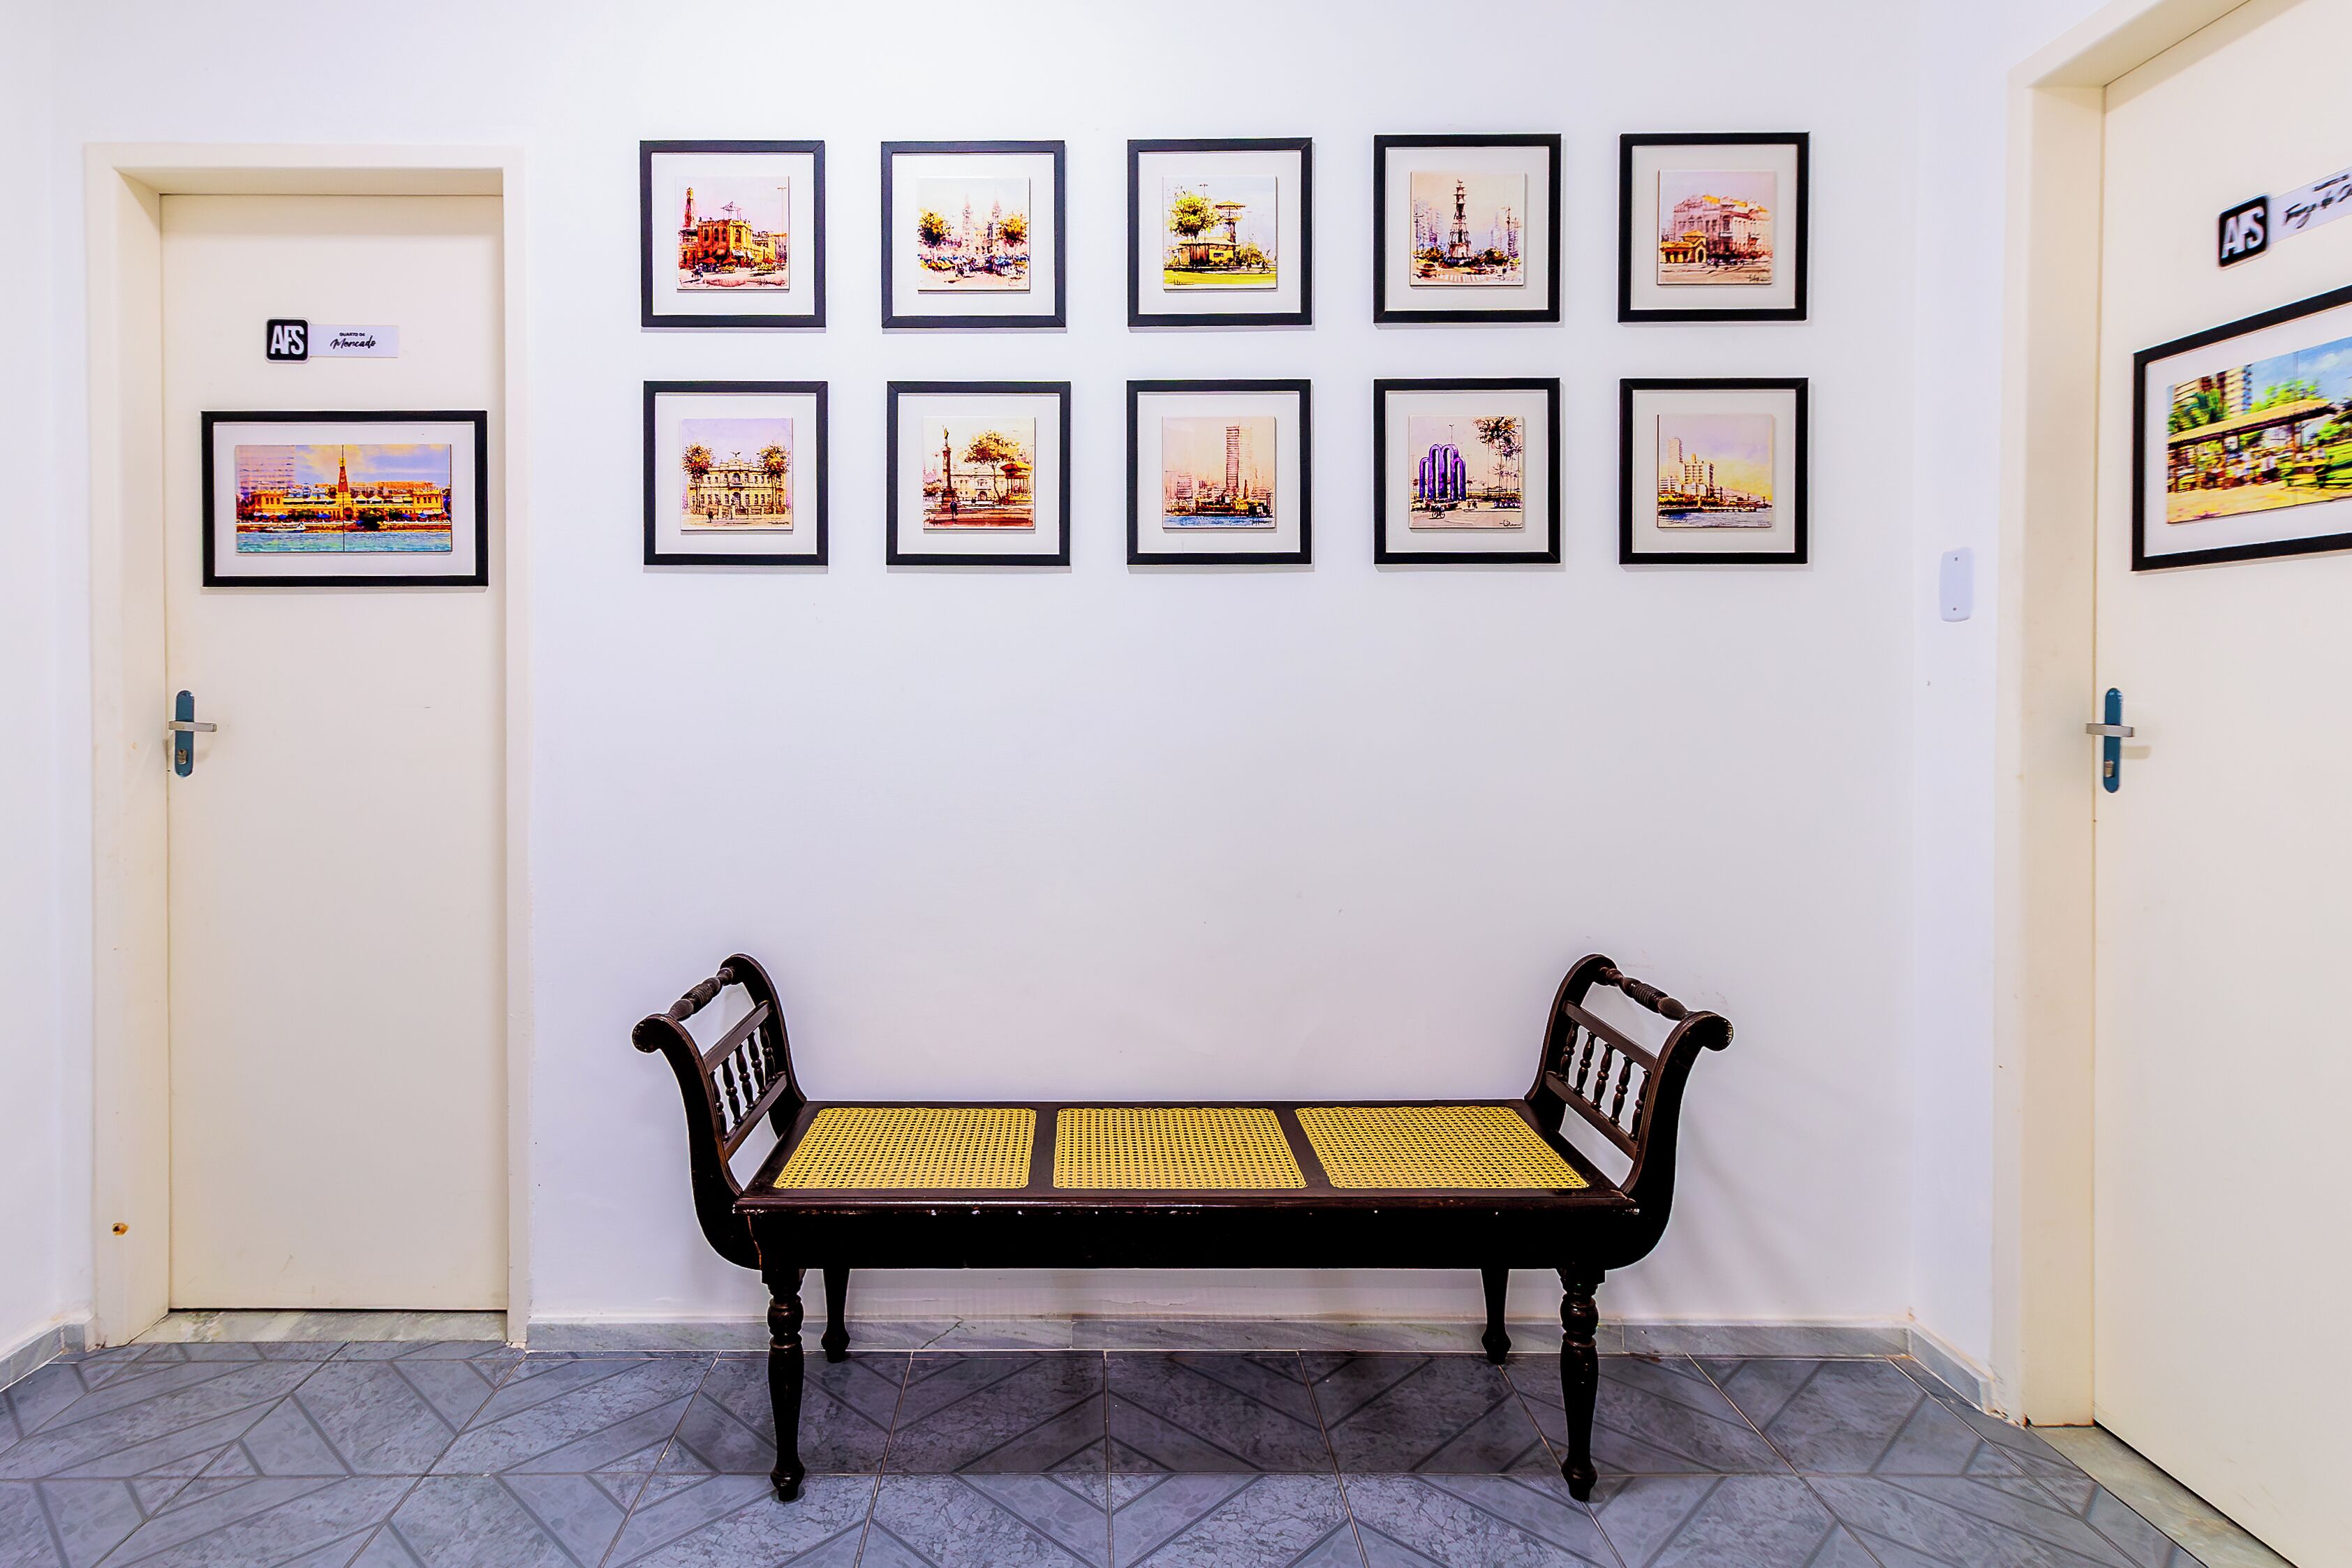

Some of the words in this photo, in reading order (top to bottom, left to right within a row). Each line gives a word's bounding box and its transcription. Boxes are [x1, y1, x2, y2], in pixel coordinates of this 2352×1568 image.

[2221, 205, 2265, 259] AFS
[269, 325, 304, 355] AFS
[330, 335, 376, 349] Mercado
